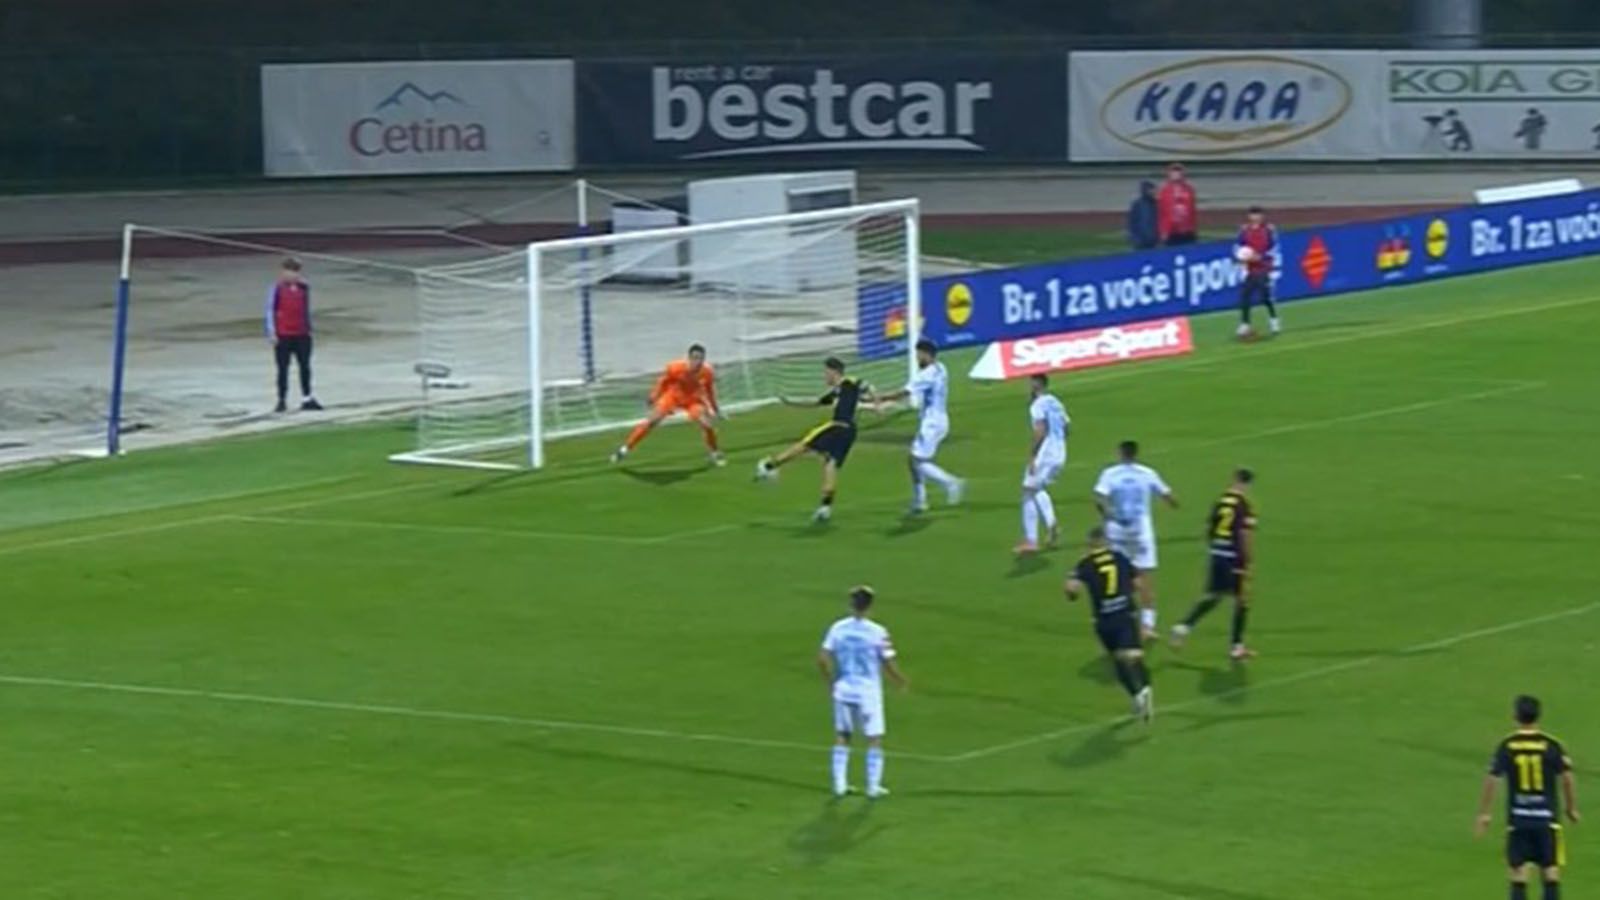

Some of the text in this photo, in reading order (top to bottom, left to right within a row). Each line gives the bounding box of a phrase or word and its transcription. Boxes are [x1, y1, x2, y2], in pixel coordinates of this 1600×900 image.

[740, 65, 774, 81] car
[652, 67, 992, 141] bestcar
[1134, 81, 1301, 122] KLARA
[349, 117, 486, 156] Cetina
[1471, 219, 1506, 256] Br.
[1508, 215, 1522, 251] 1
[1525, 220, 1554, 250] za
[1002, 284, 1043, 325] Br.
[1045, 278, 1060, 318] 1
[1065, 284, 1098, 316] za
[1102, 265, 1171, 309] voće
[1174, 255, 1186, 298] i
[1010, 318, 1181, 368] SuperSport
[1215, 507, 1236, 536] 2
[1098, 564, 1119, 596] 7
[1514, 754, 1544, 790] 11
